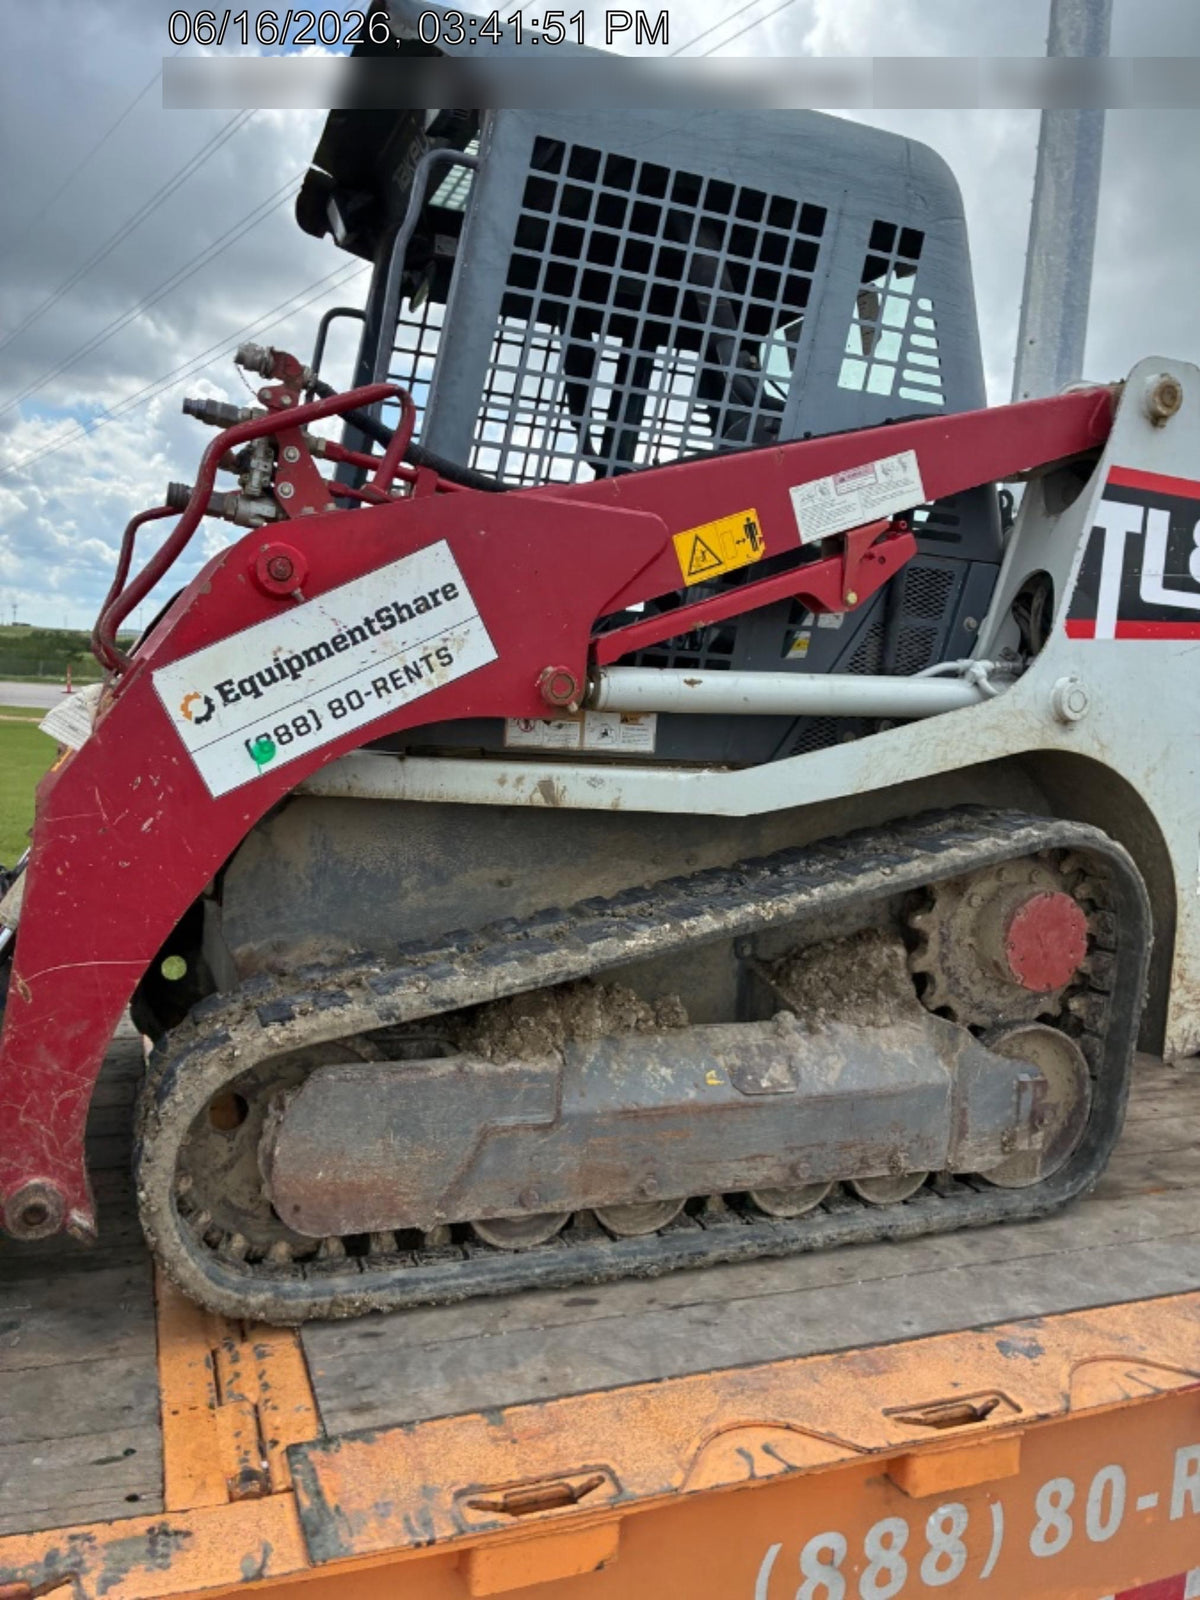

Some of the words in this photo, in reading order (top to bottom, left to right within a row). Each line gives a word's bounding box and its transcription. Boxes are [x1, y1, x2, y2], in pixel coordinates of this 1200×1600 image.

[1093, 500, 1200, 640] TL
[214, 581, 460, 707] EquipmentShare
[244, 708, 322, 763] (88)
[326, 645, 455, 720] 80-RENTS
[754, 1501, 1004, 1600] (888)
